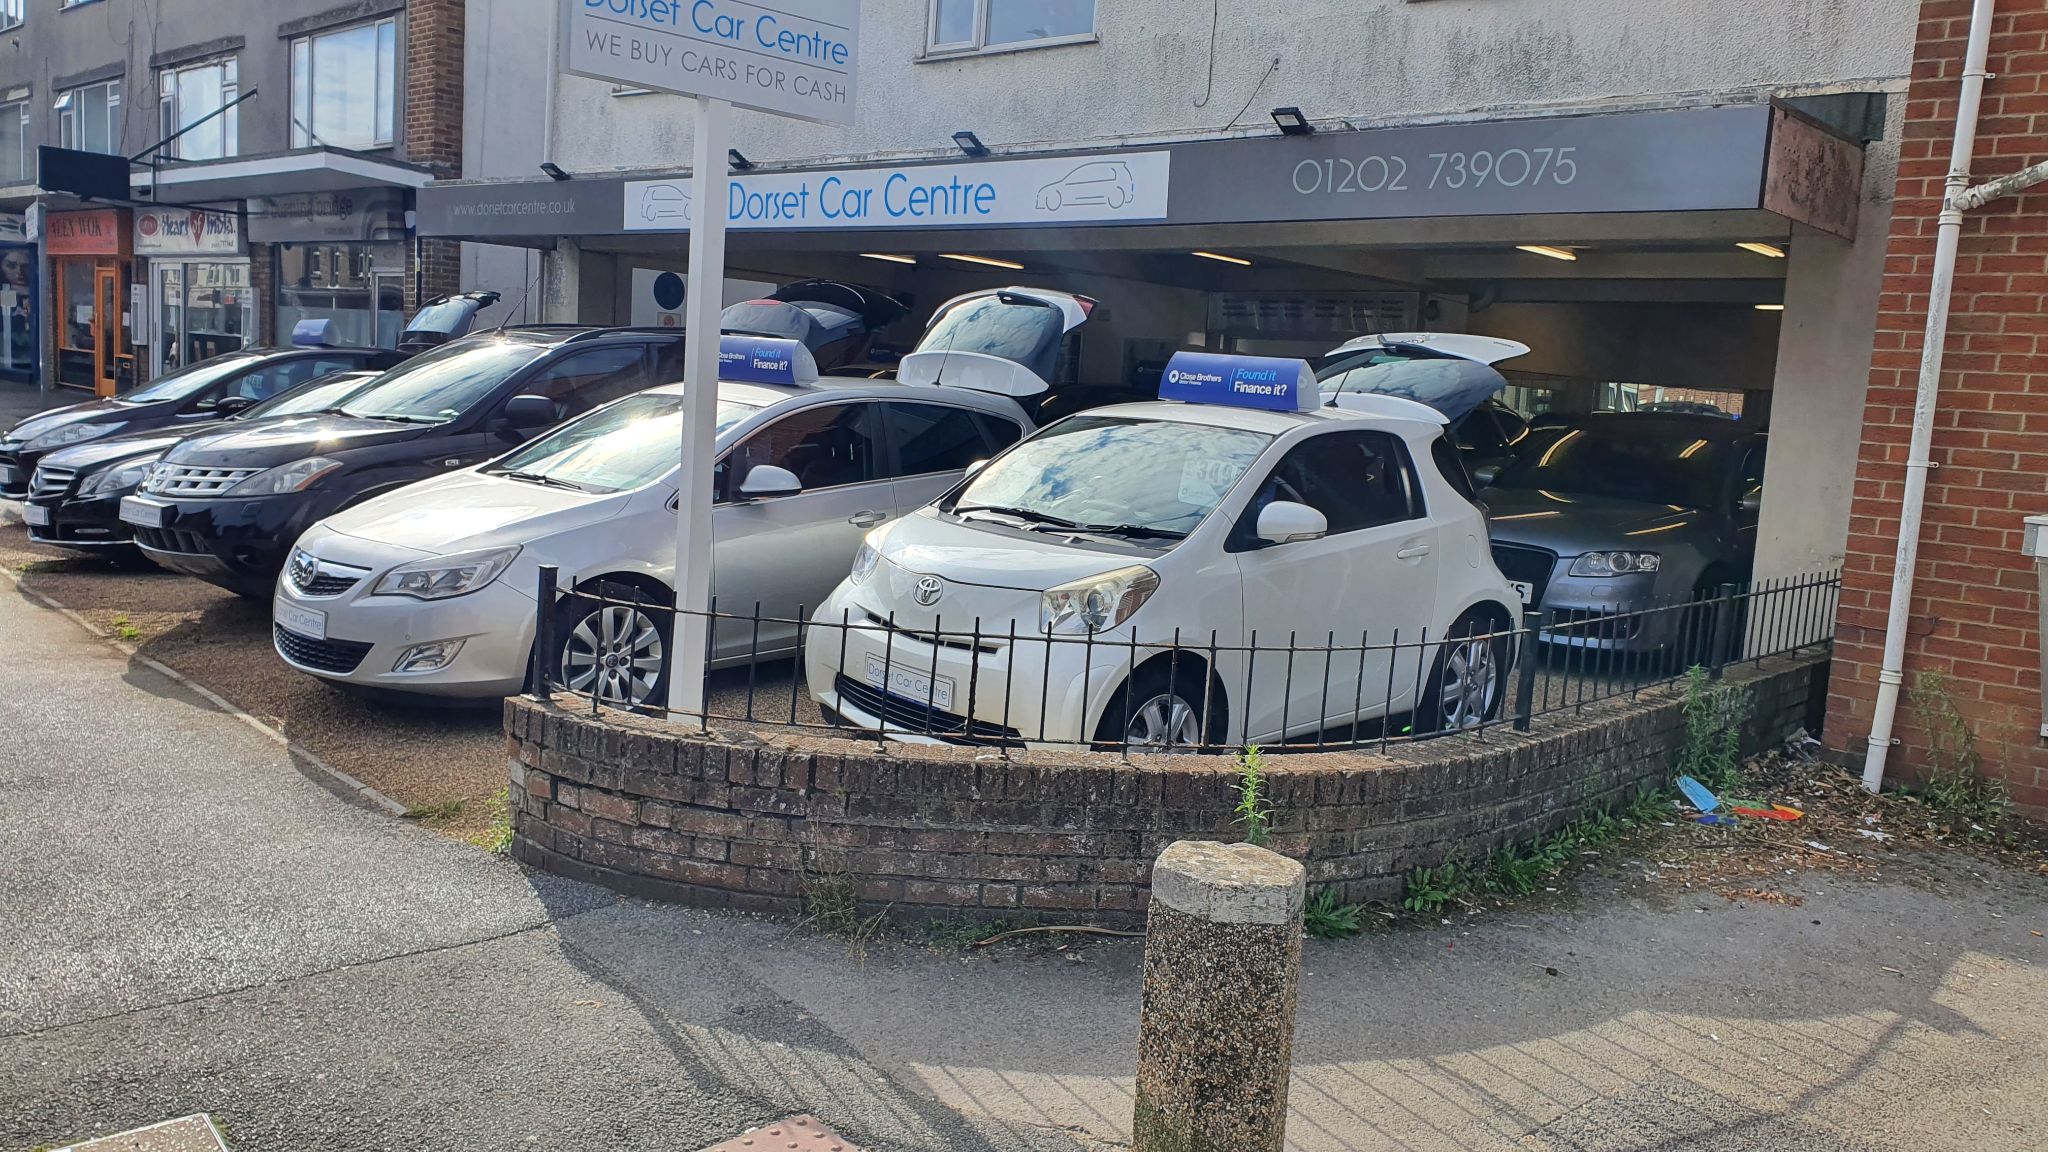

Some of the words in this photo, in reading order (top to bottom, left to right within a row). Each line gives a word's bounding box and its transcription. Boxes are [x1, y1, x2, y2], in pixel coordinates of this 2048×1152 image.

[692, 0, 744, 40] Car
[756, 15, 849, 65] Centre
[586, 29, 621, 56] WE
[631, 39, 672, 67] BUY
[681, 51, 737, 81] CARS
[746, 64, 785, 91] FOR
[794, 76, 846, 104] CASH
[1292, 155, 1408, 195] 01202
[1428, 147, 1577, 190] 739075
[729, 181, 809, 220] Dorset
[819, 176, 873, 219] Car
[884, 173, 996, 217] Centre
[78, 215, 102, 237] WOK
[161, 213, 190, 236] Heart
[192, 213, 203, 234] of
[755, 348, 775, 358] Found
[754, 359, 778, 370] Finance
[779, 361, 788, 371] it?
[1236, 368, 1268, 381] Found
[1268, 370, 1277, 382] it
[1180, 372, 1197, 381] Close
[1197, 373, 1221, 383] Brothers
[1234, 381, 1272, 395] Finance
[1273, 383, 1288, 396] it?
[300, 614, 321, 630] Centre
[895, 673, 913, 688] Car
[914, 679, 948, 700] Cetre
